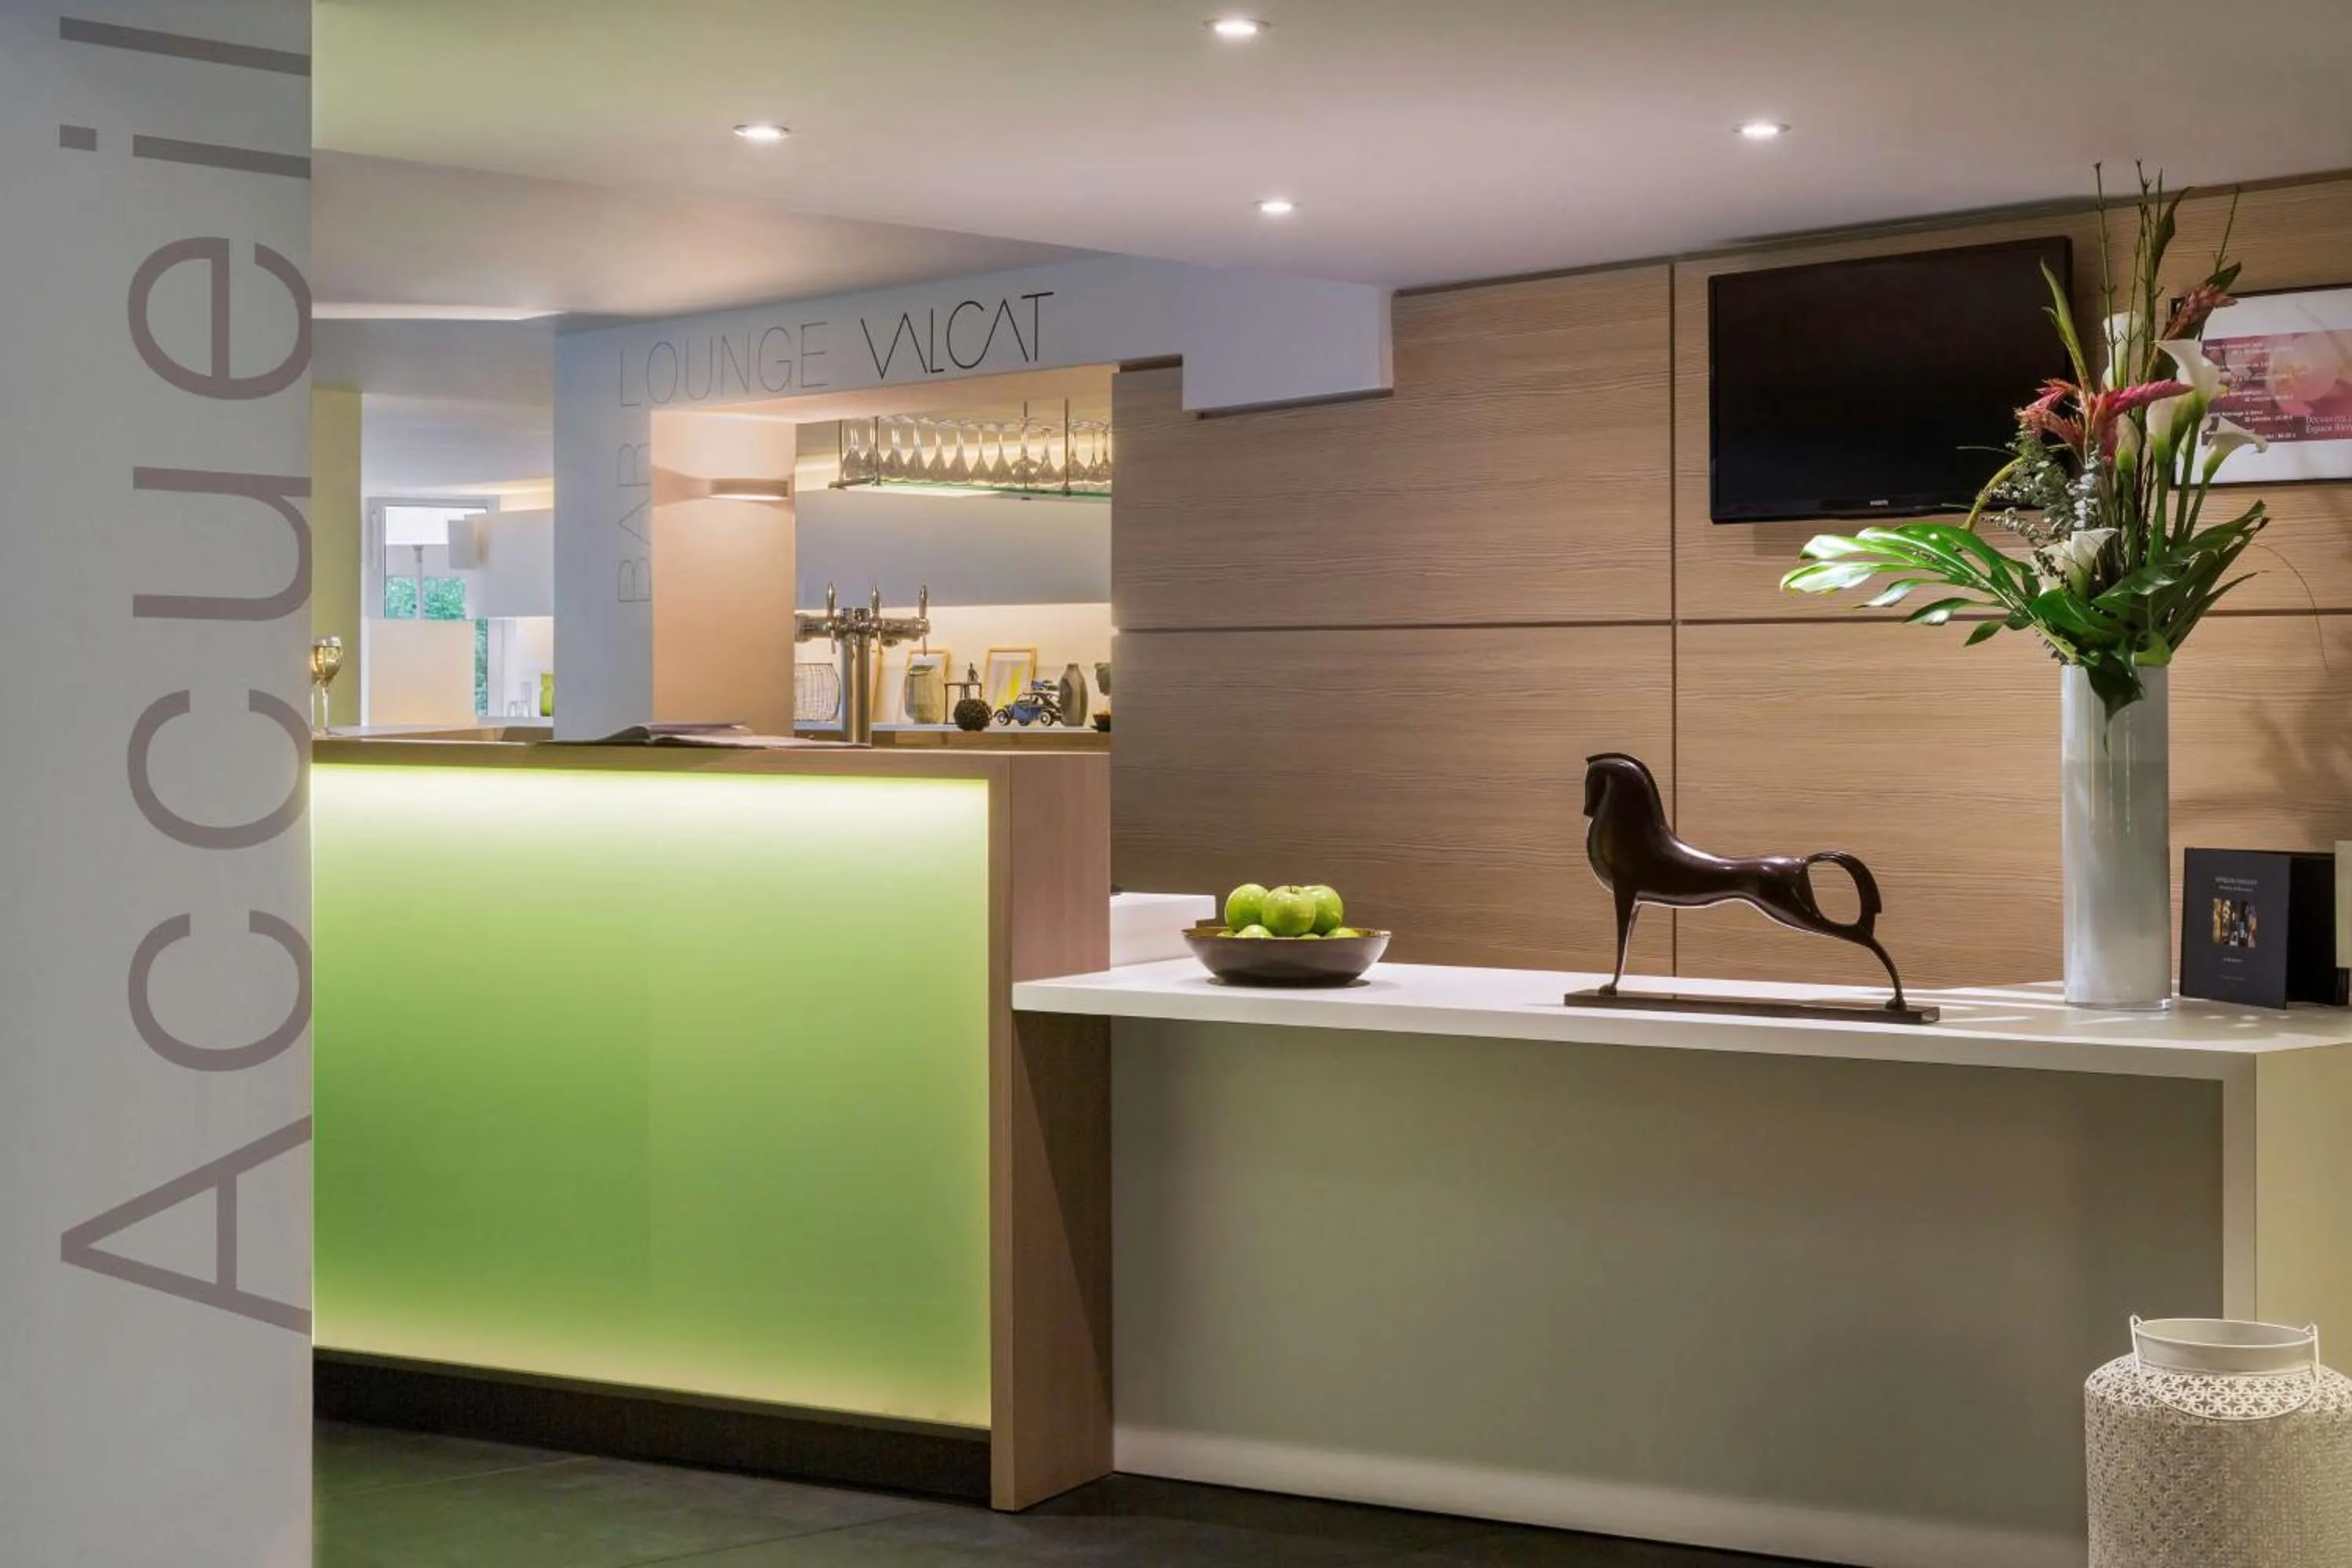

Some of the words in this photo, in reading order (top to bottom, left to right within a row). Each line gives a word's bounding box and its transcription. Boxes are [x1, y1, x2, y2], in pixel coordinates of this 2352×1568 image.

[619, 321, 829, 408] LOUNGE
[860, 291, 1054, 380] VALCAT
[616, 441, 652, 604] BAR
[59, 16, 312, 1336] Accueil
